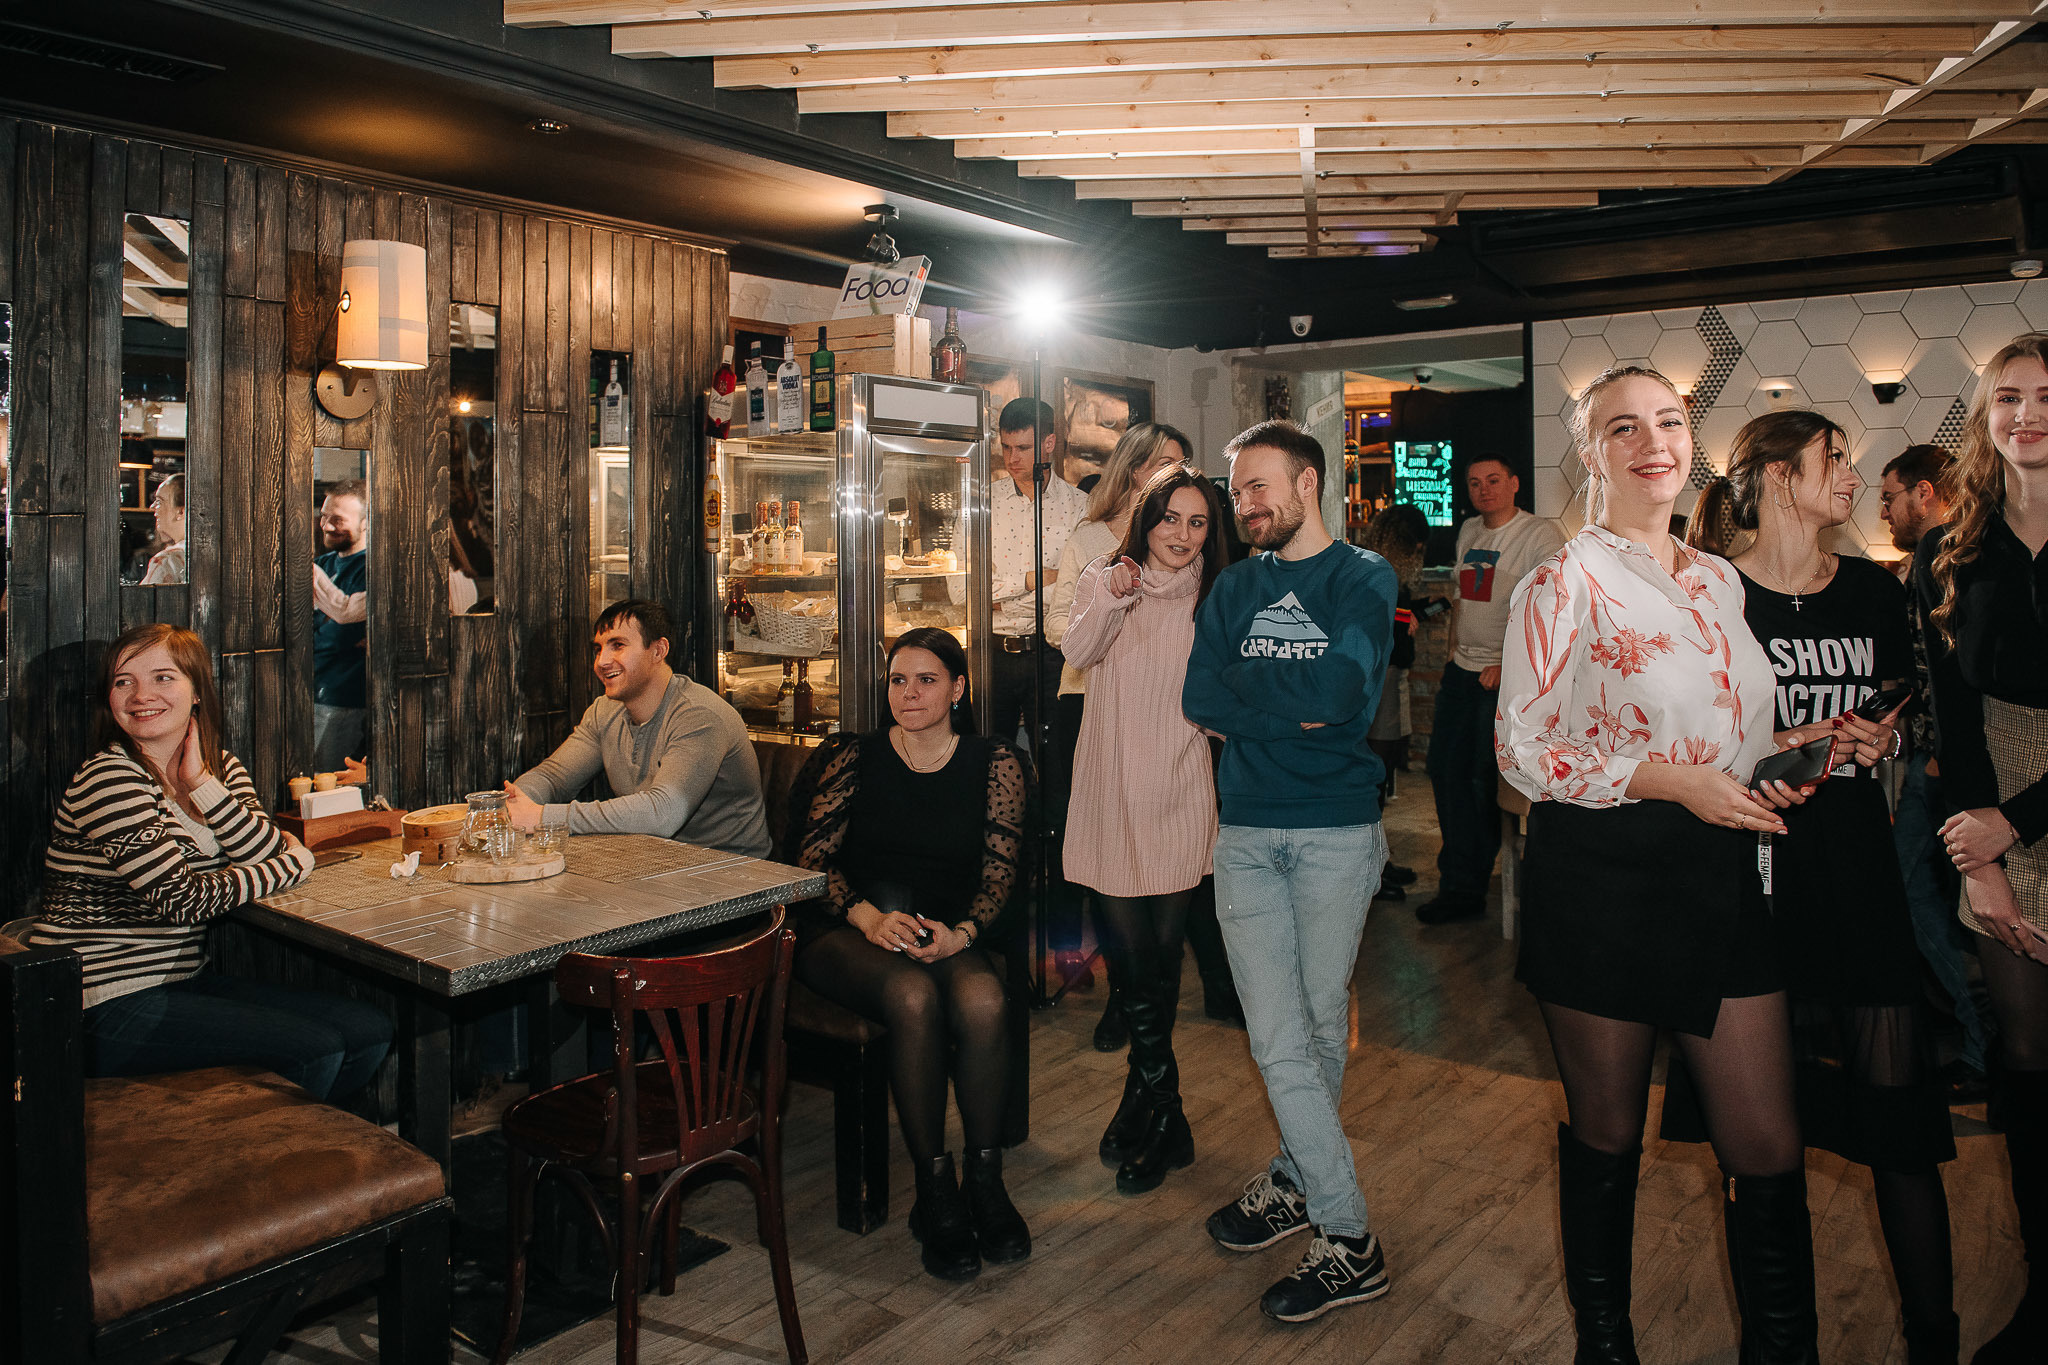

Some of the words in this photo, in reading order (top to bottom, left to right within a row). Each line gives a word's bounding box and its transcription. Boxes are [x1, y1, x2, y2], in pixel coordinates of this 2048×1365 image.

[842, 271, 913, 302] Food
[781, 375, 800, 383] ABSOLUT
[782, 381, 799, 390] VODKA
[1408, 457, 1428, 467] ВИНО
[1769, 637, 1874, 677] SHOW
[1317, 1261, 1352, 1294] N
